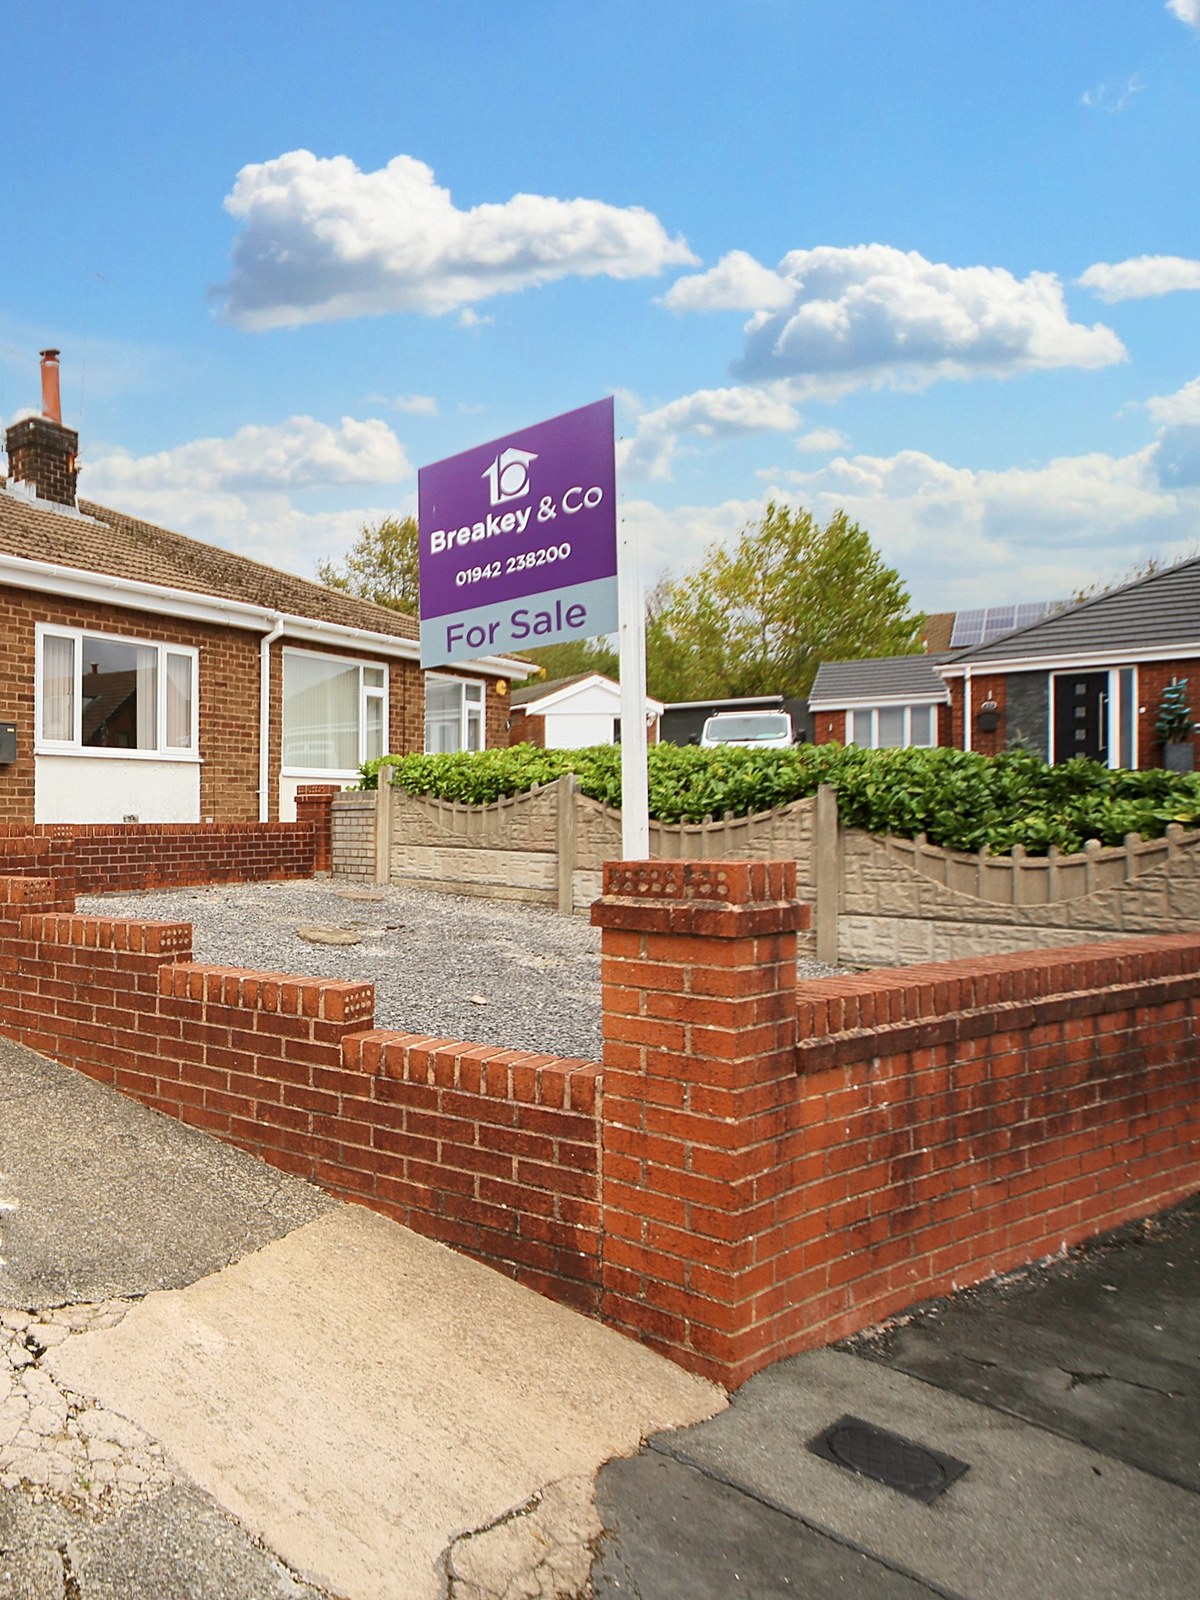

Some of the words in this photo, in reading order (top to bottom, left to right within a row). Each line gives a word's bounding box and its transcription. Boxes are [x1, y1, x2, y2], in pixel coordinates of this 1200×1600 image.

[430, 505, 533, 555] Breakey
[537, 496, 557, 522] &
[562, 487, 603, 514] Co
[455, 560, 502, 587] 01942
[505, 542, 572, 575] 238200
[446, 621, 501, 653] For
[510, 600, 588, 640] Sale
